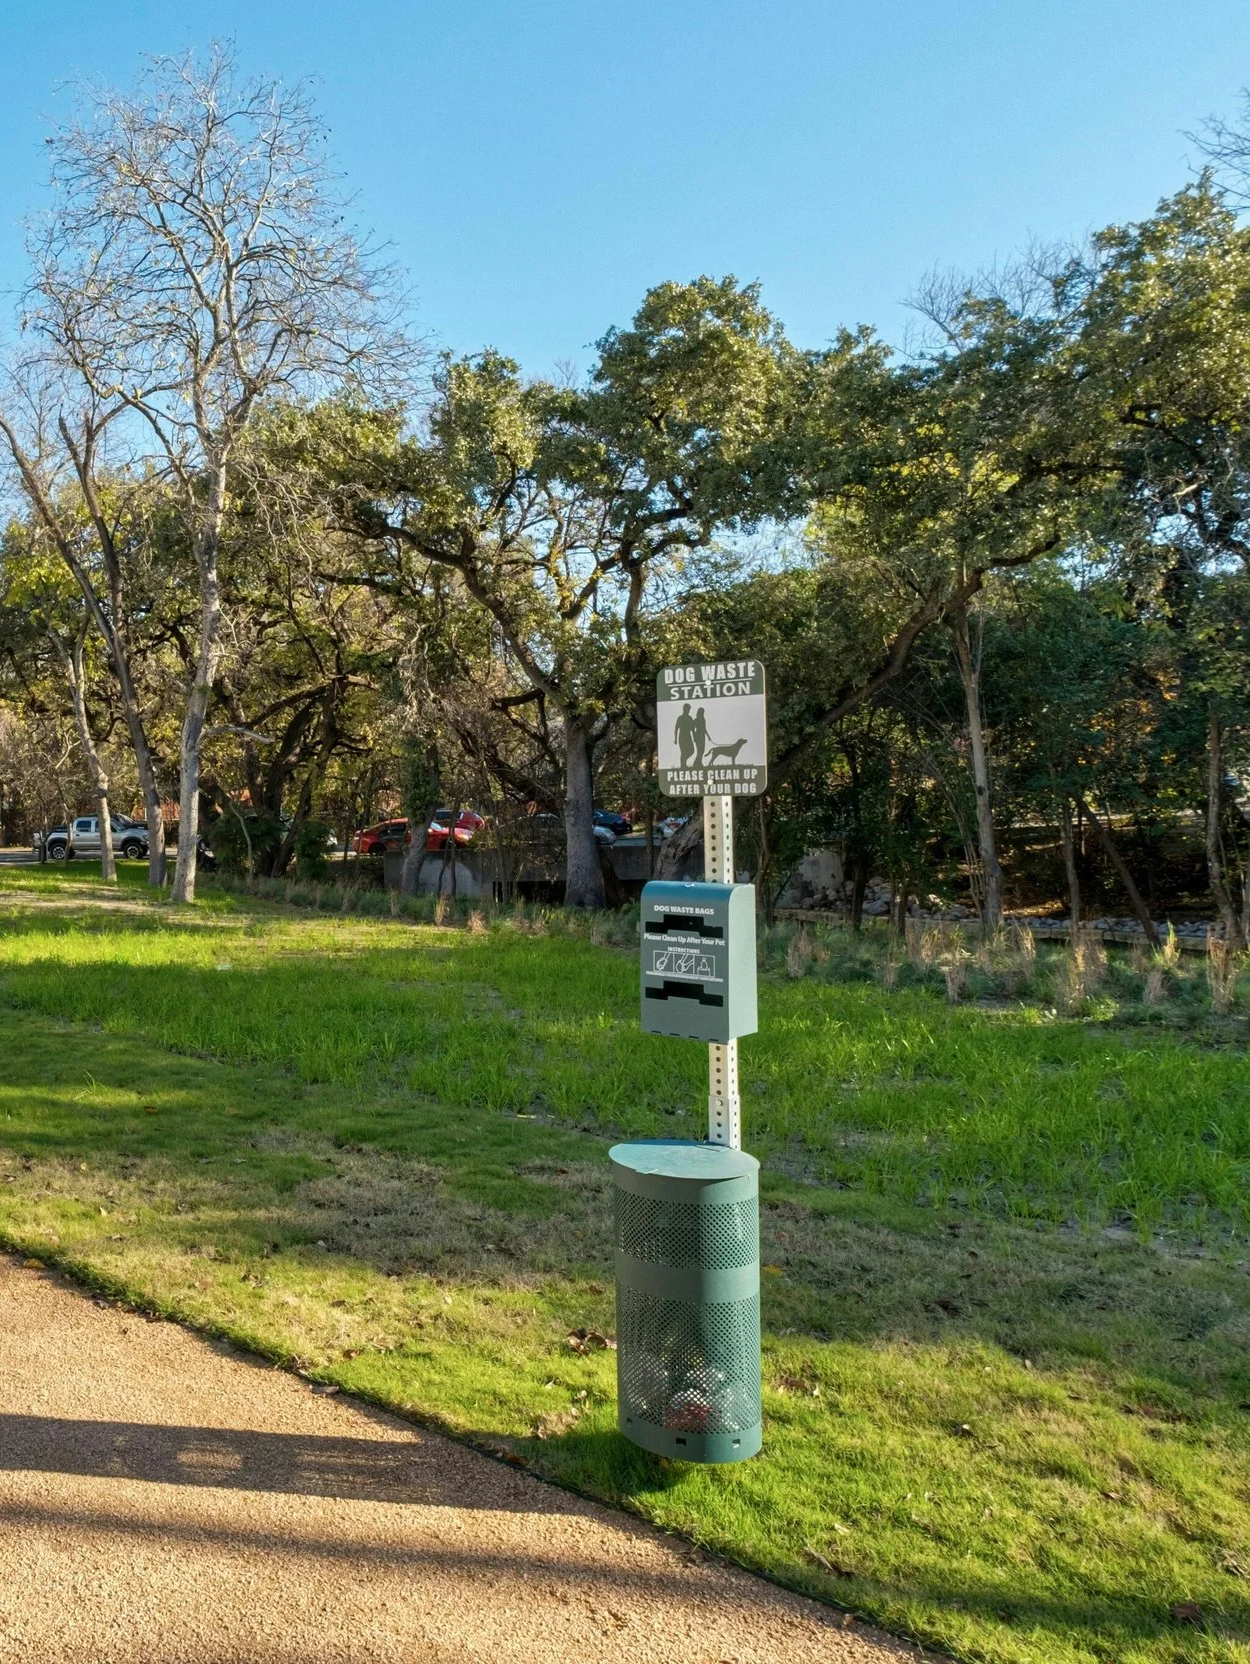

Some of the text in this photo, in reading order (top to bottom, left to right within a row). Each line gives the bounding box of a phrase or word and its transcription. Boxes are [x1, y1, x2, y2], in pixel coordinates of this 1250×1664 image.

[664, 662, 755, 684] DOG WASTE
[670, 682, 751, 700] STATION
[668, 769, 758, 781] PLEASE CLEAN UP
[670, 783, 756, 795] AFTER YOUR DOG
[678, 936, 686, 944] Up
